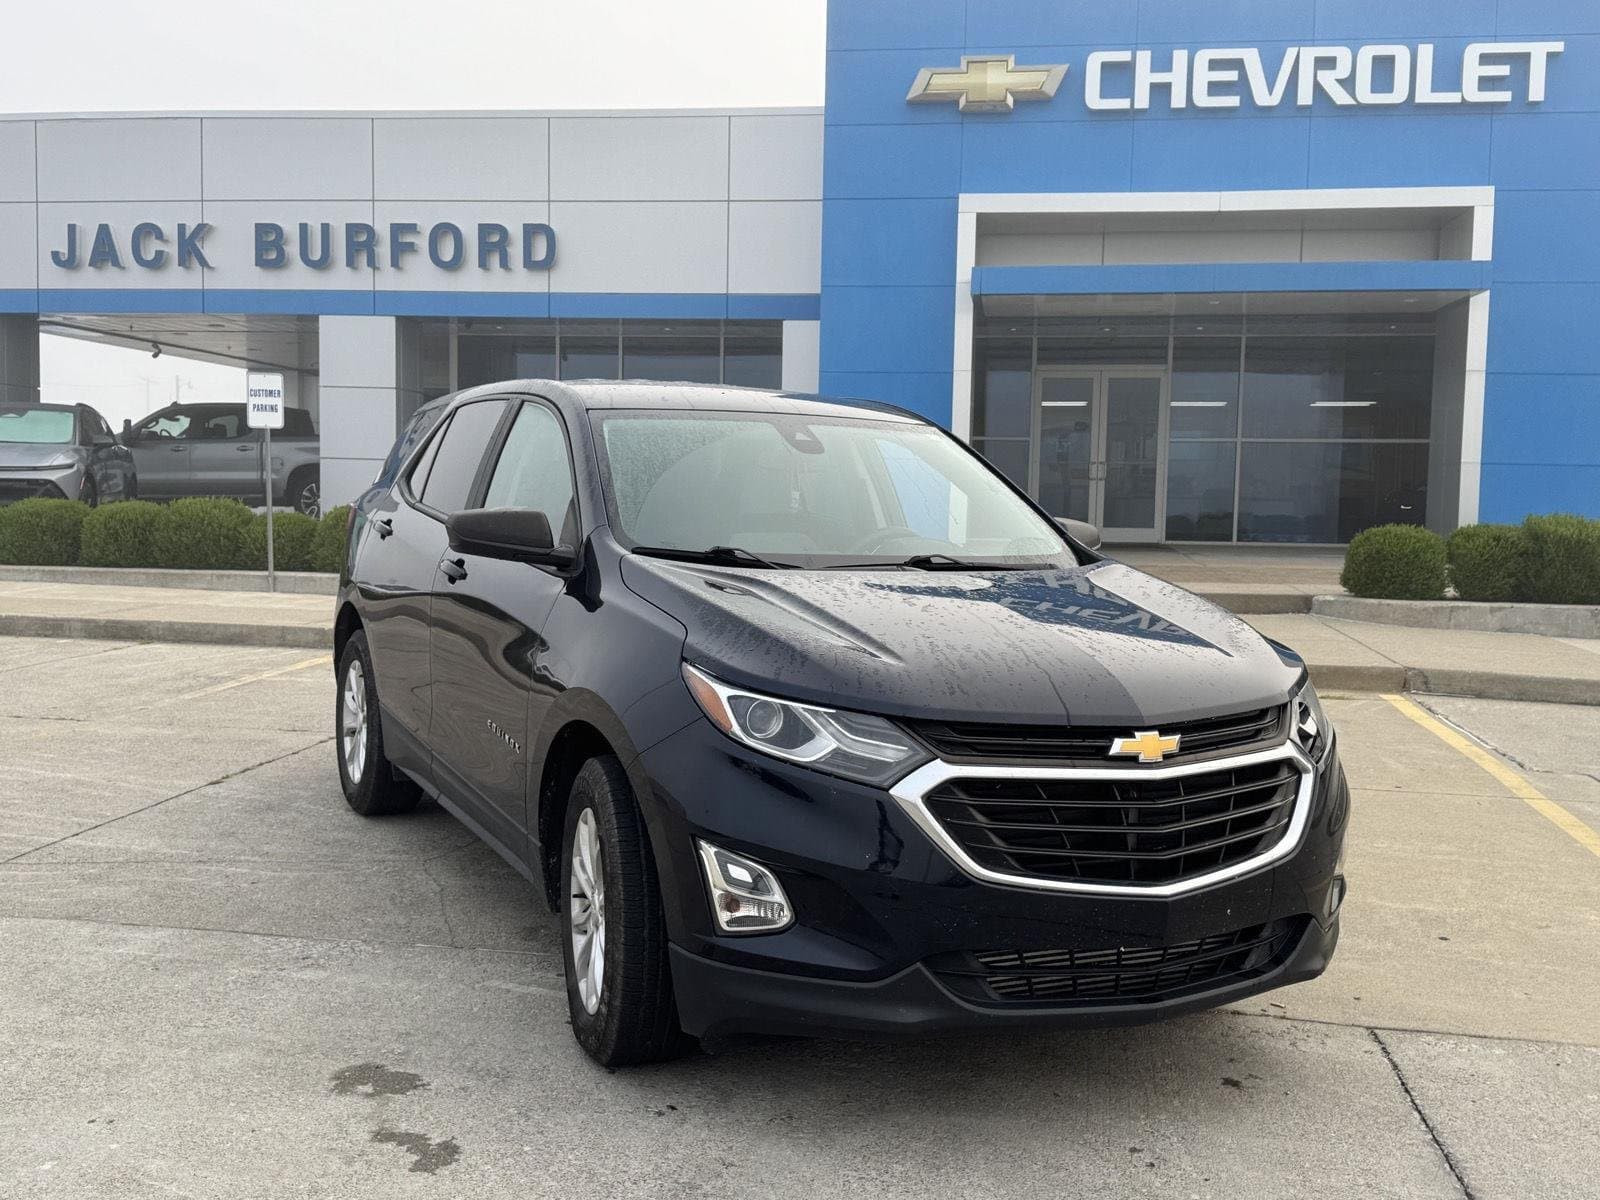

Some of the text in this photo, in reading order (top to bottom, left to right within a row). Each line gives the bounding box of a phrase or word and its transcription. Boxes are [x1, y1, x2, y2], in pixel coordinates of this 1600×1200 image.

[1084, 40, 1565, 111] CHEVROLET
[51, 223, 556, 270] JACK BURFORD
[249, 388, 281, 398] CUSTOMER
[252, 403, 279, 413] PARKING
[486, 719, 520, 754] EQUINOX
